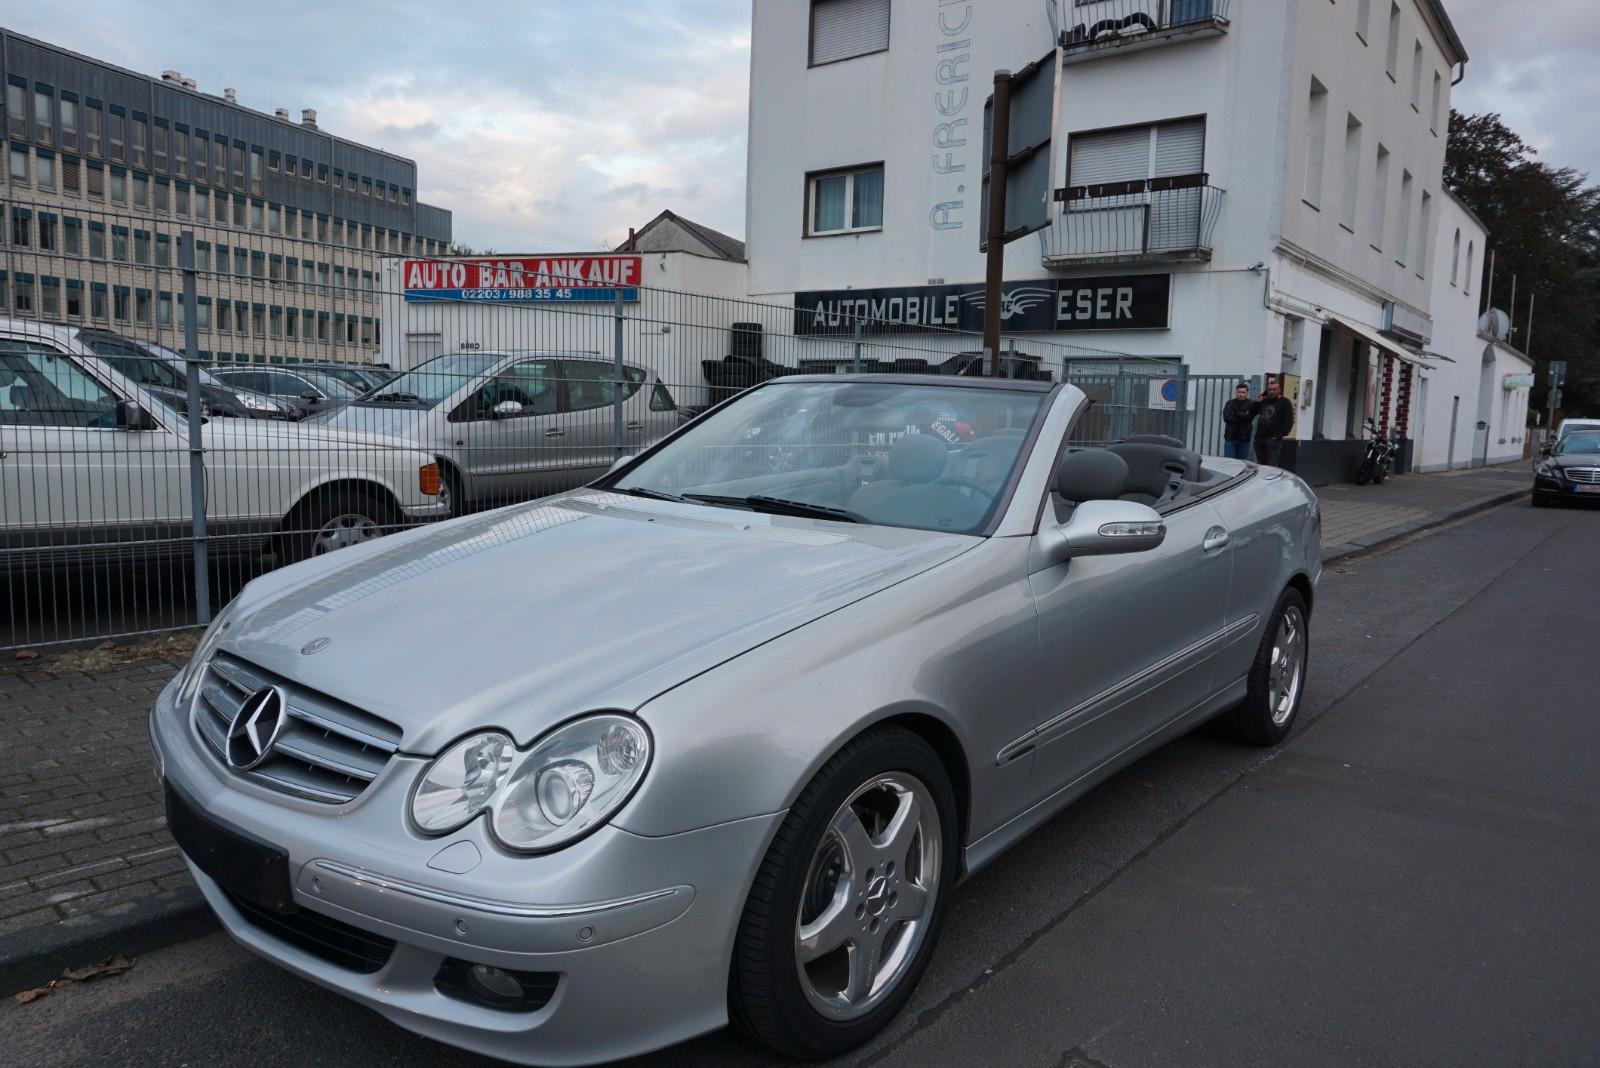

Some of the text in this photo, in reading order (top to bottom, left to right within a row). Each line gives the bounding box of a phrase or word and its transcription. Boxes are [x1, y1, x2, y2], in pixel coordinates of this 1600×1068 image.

[408, 259, 635, 289] AUTO BAR-ANKAUF
[535, 289, 551, 298] 35
[555, 289, 572, 298] 45
[813, 287, 1133, 327] AUTOMOBILE ESER
